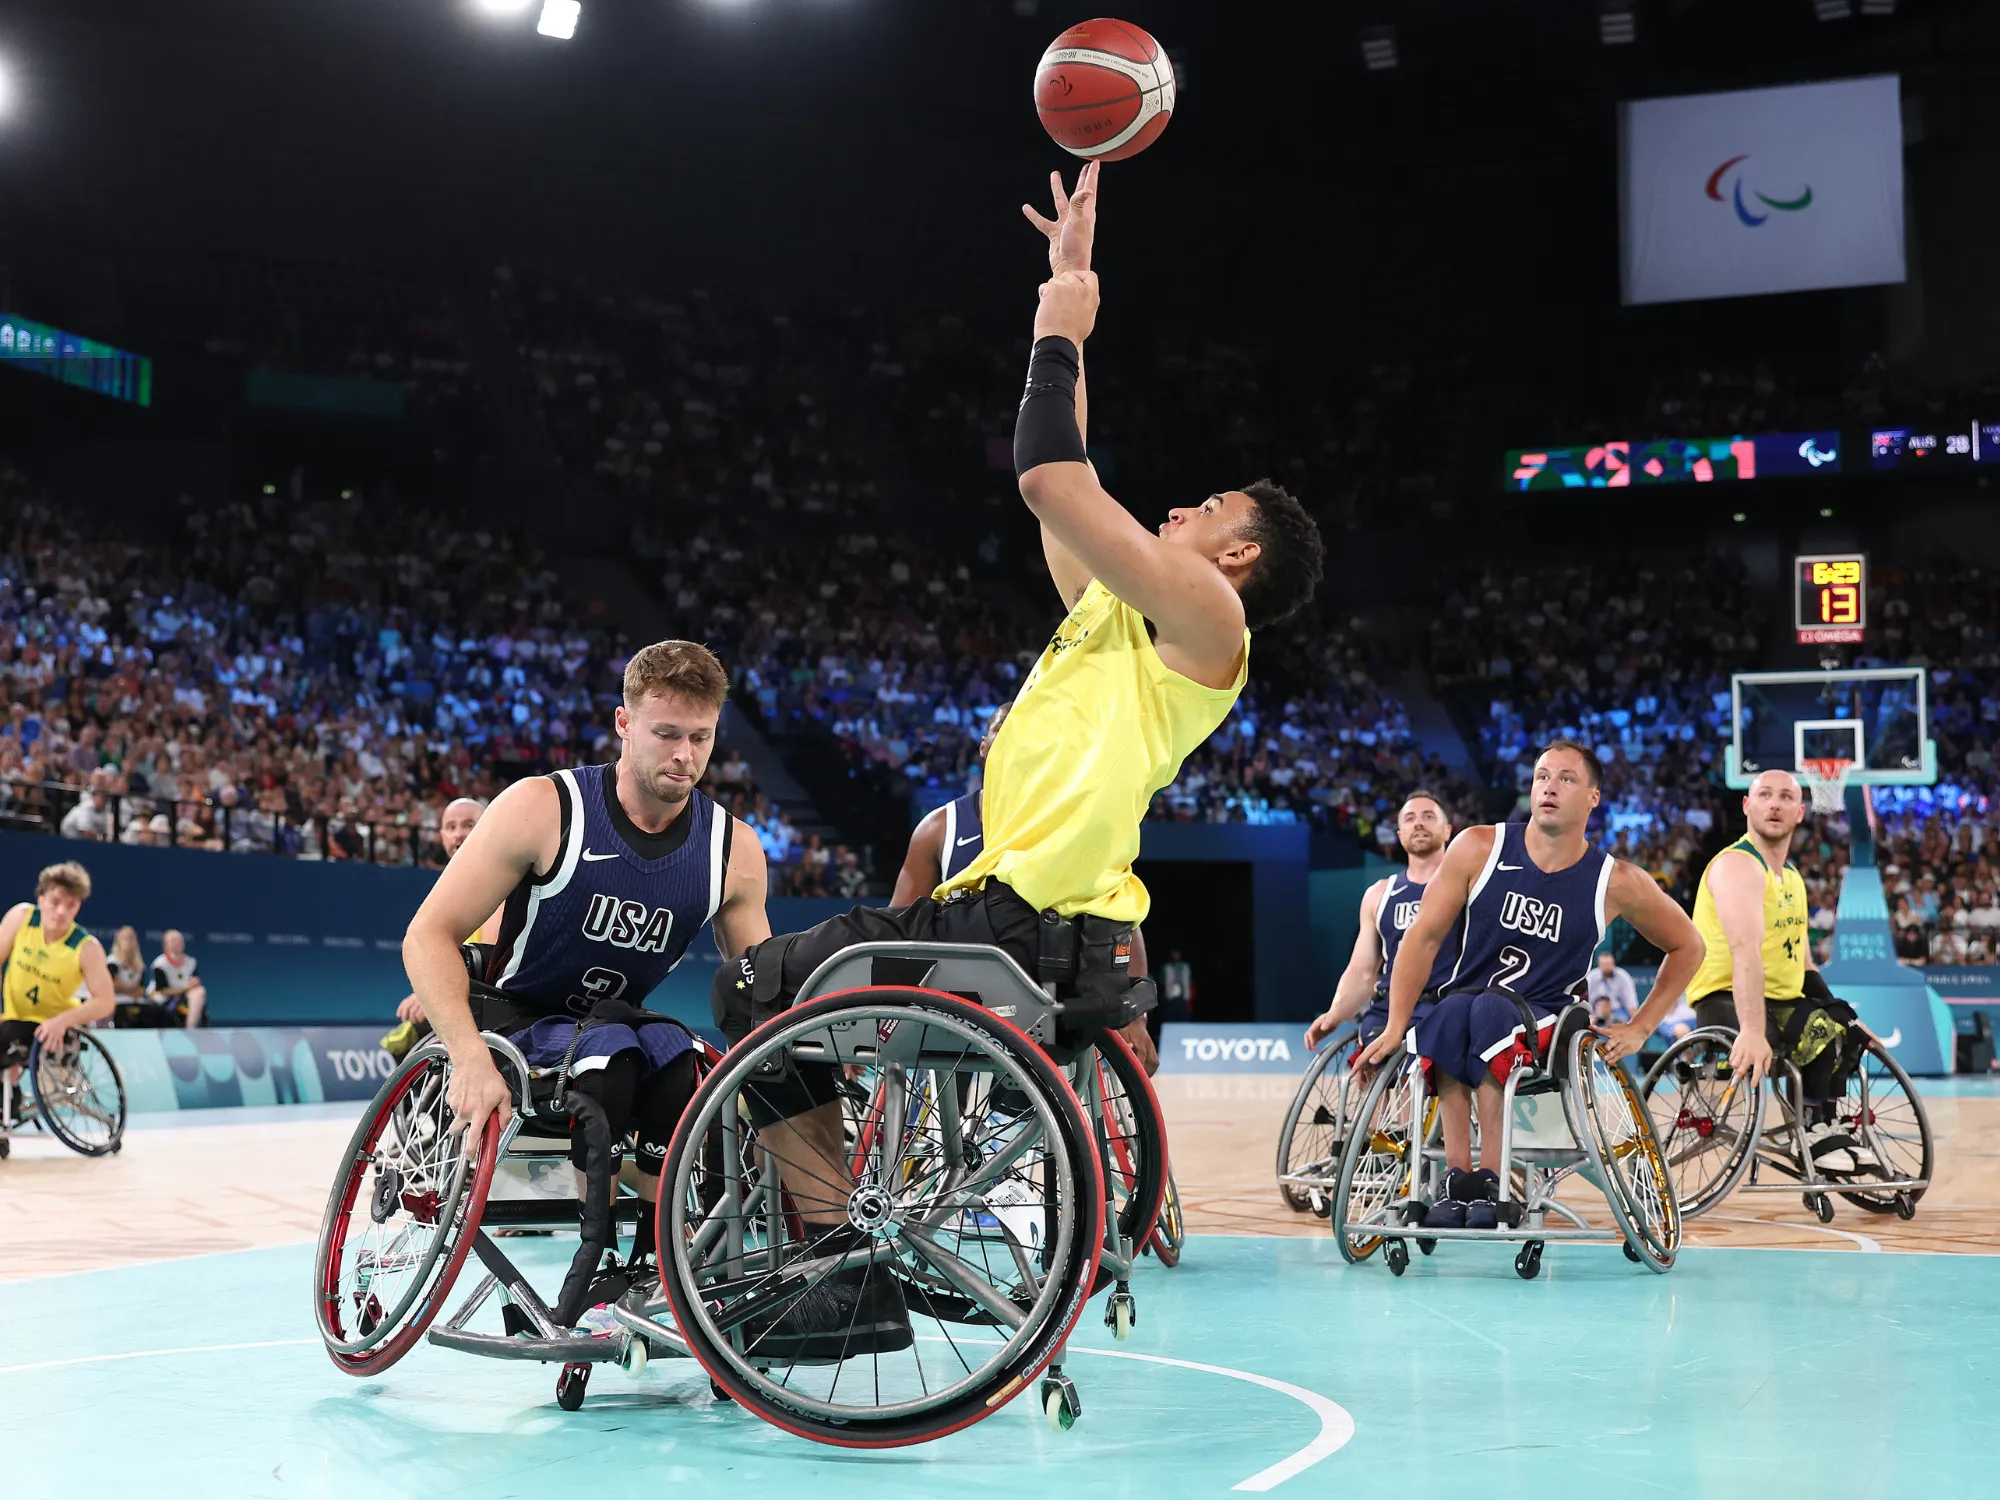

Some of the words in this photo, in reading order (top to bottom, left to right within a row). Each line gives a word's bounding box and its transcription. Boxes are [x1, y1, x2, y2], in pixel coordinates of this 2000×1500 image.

[1813, 561, 1860, 584] 6:23
[1821, 587, 1858, 623] 13
[582, 893, 674, 953] USA
[1394, 900, 1420, 931] US
[1499, 891, 1563, 943] USA
[739, 958, 755, 985] AUS
[1487, 945, 1531, 993] 2
[25, 984, 40, 1006] 4
[566, 966, 628, 1015] 3
[327, 1050, 396, 1081] TOYO
[1181, 1038, 1291, 1062] TOYOTA
